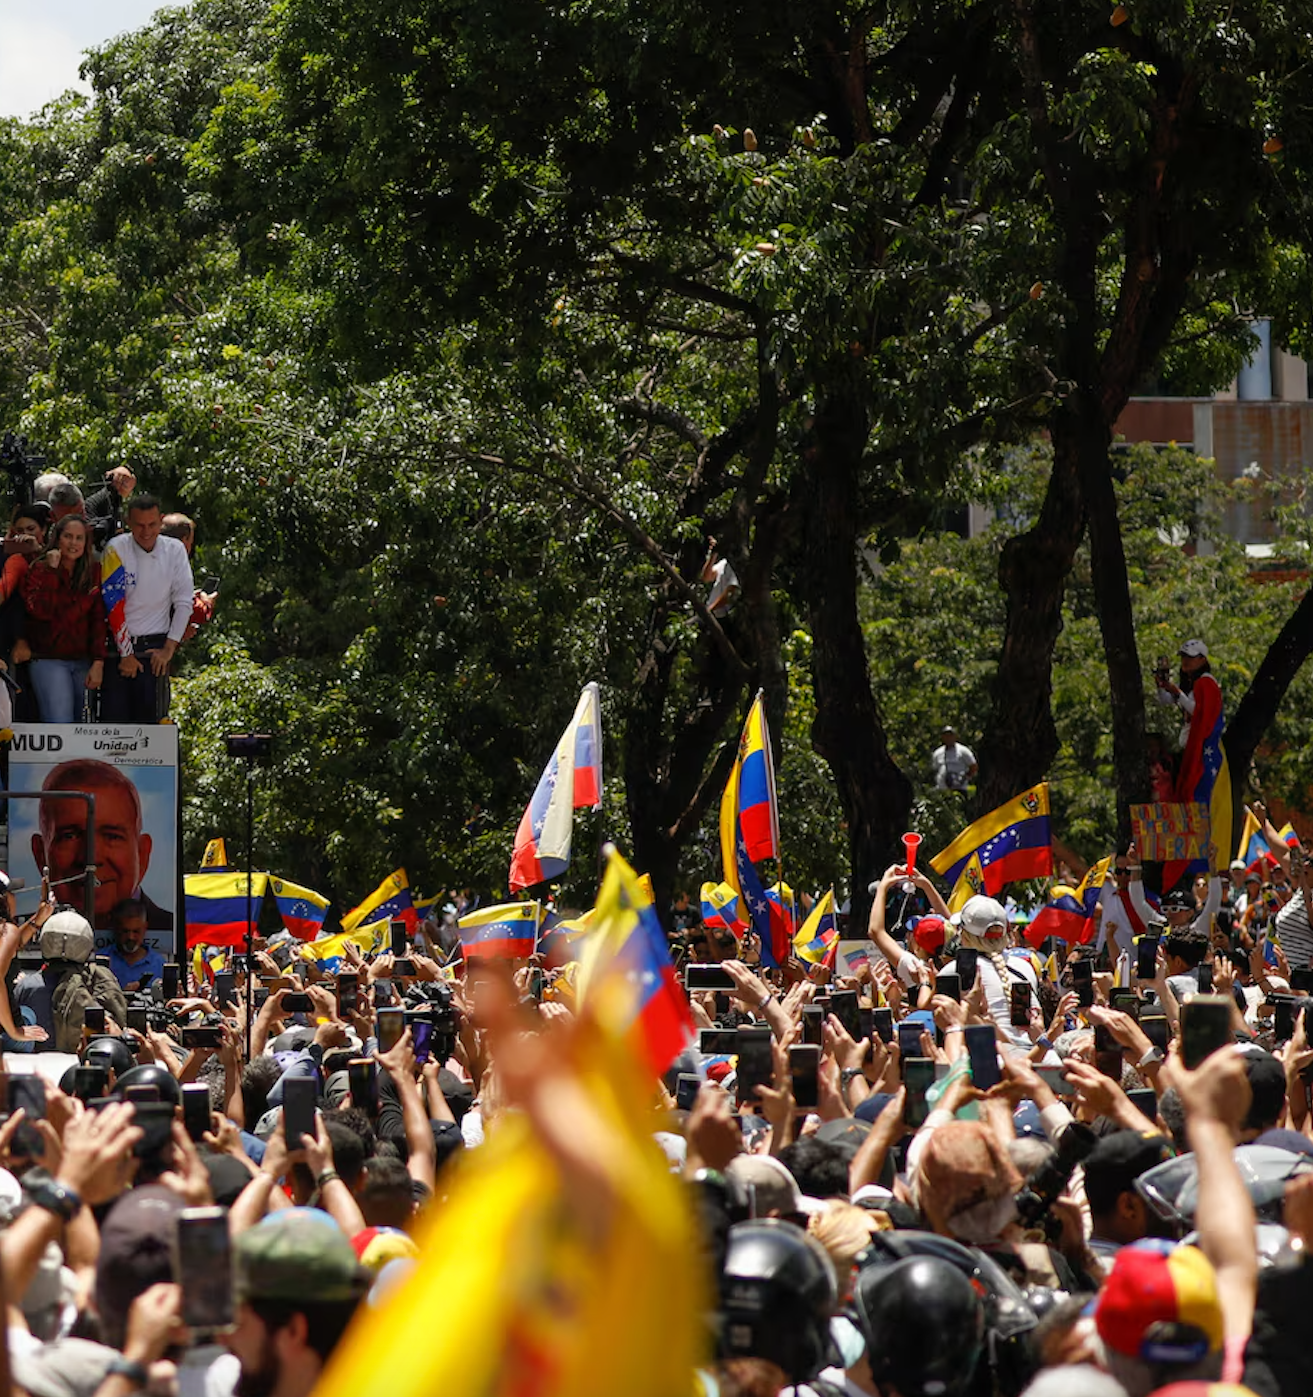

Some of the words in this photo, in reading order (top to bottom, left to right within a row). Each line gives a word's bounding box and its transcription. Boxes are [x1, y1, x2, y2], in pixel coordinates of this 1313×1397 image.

[74, 727, 98, 735] Mesa
[10, 734, 63, 751] MUD
[93, 740, 138, 751] Unidad
